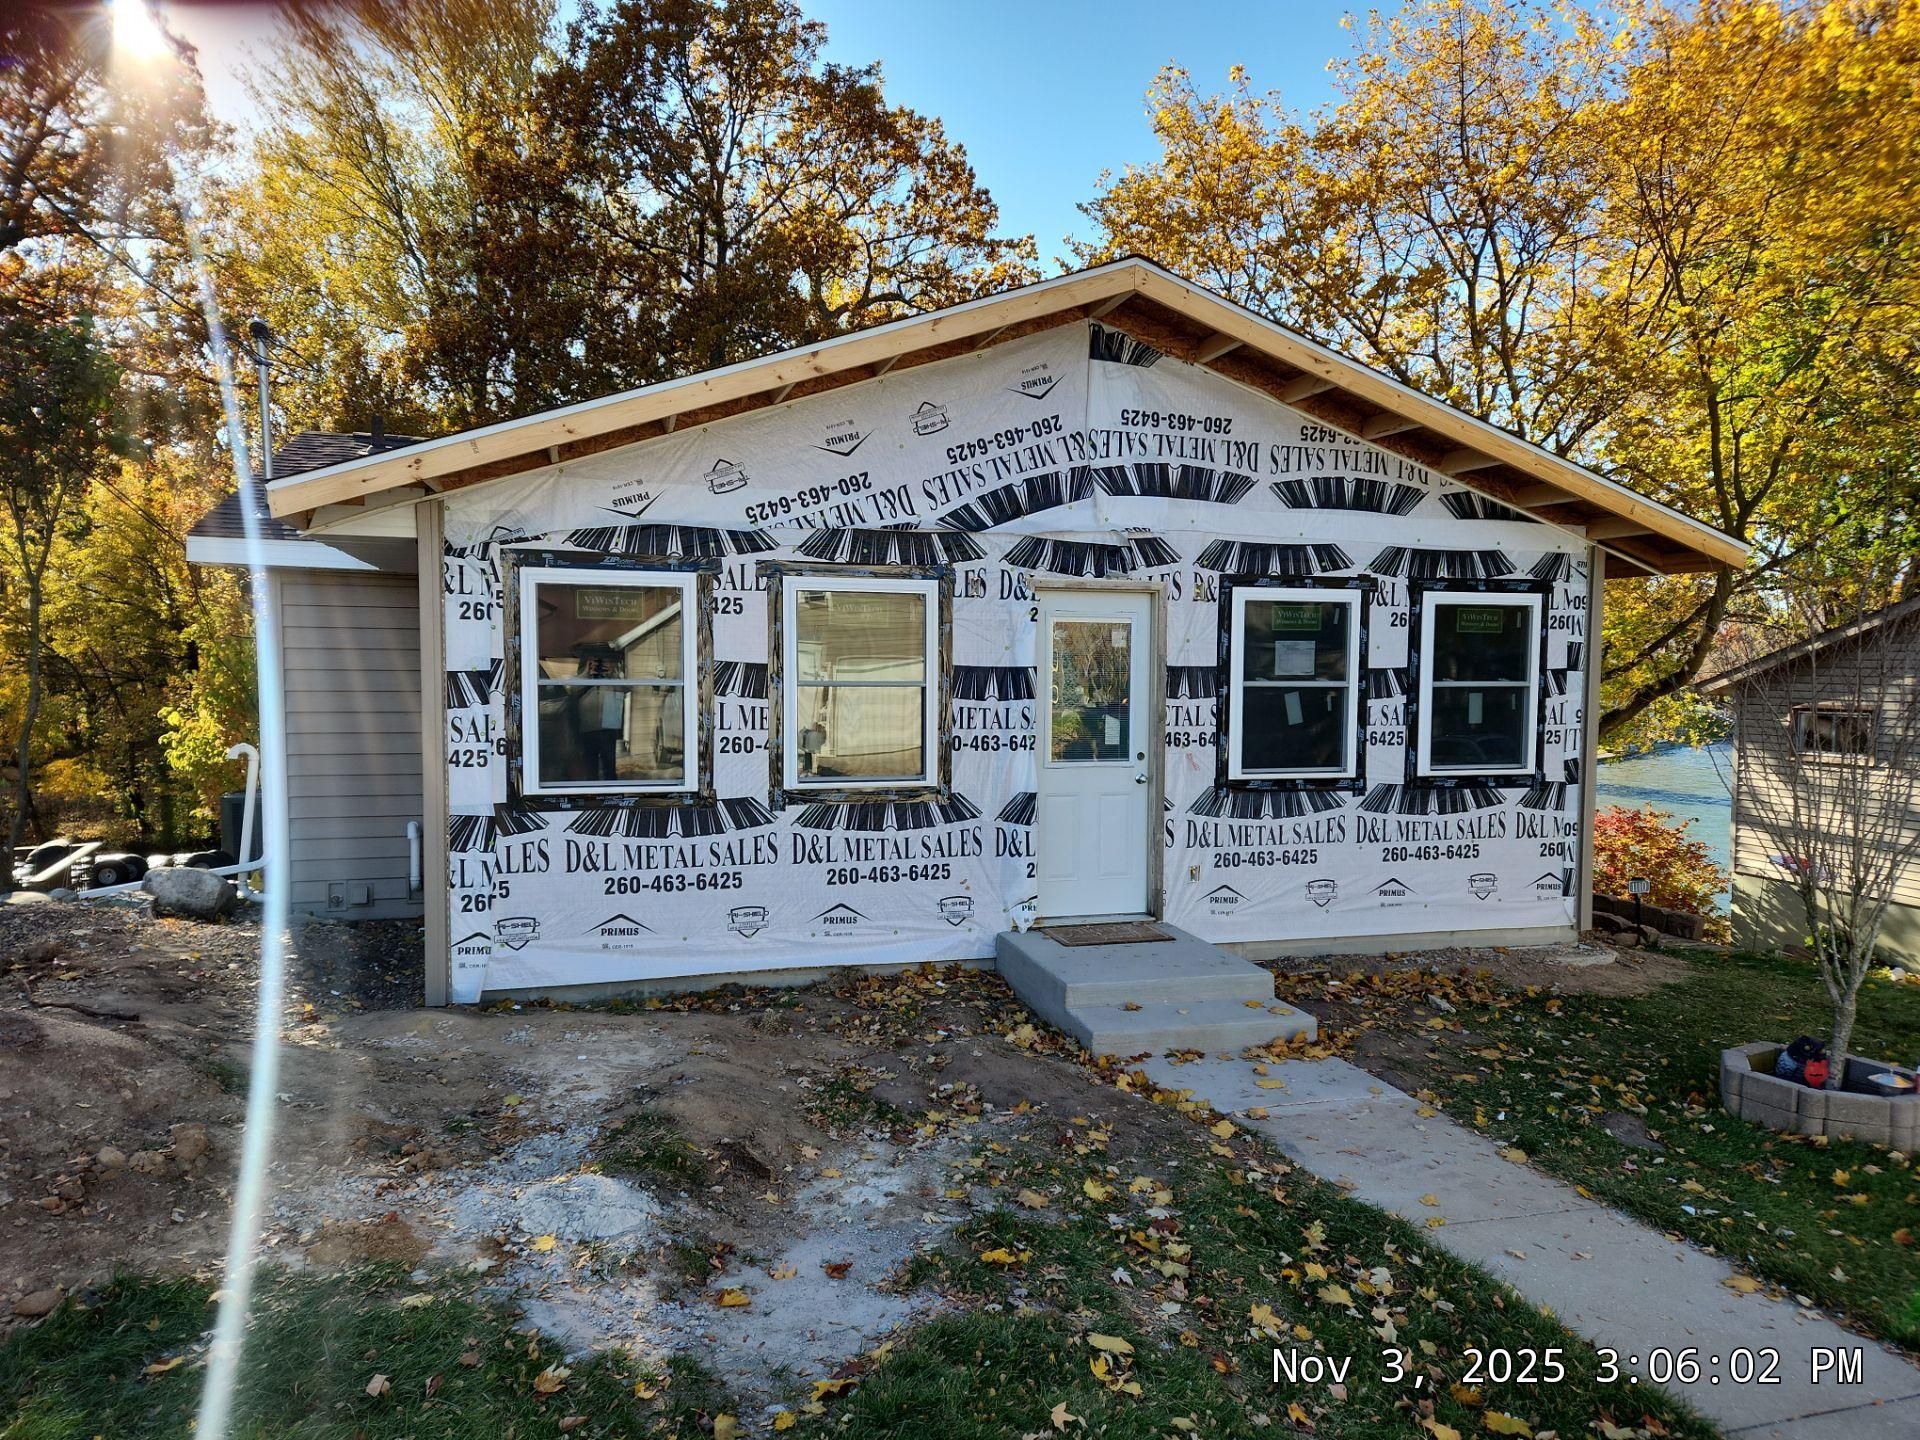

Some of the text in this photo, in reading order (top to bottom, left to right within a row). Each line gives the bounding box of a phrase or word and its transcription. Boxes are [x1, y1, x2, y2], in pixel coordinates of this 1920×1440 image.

[1020, 376, 1053, 391] PRIMUS
[1121, 408, 1232, 435] 260-463-6425
[825, 431, 860, 447] PRIMUS
[946, 414, 1063, 465] 260-463-6425
[1088, 428, 1260, 473] D&L METAL SALES
[985, 442, 1058, 481] METAL
[1270, 443, 1325, 475] SALES
[1327, 447, 1389, 476] METAL
[611, 491, 651, 508] PRIMUS
[745, 471, 873, 524] 260-463-6425
[866, 483, 917, 521] D&L
[922, 463, 987, 512] SALES
[1186, 814, 1346, 849] D&L METAL SALES
[1356, 811, 1507, 844] D&L METAL SALES
[1515, 811, 1549, 840] D&L
[565, 832, 778, 874] D&L METAL SALES
[792, 825, 983, 865] D&L METAL SALES
[995, 826, 1036, 858] D&L
[1382, 843, 1480, 863] 260-463-6425
[1213, 849, 1318, 869] 260-463-6425
[604, 871, 743, 896] 260-463-6425
[826, 863, 951, 886] 260-463-6425
[1536, 883, 1562, 891] PRIMUS
[1209, 896, 1239, 905] PRIMUS
[1378, 888, 1406, 897] PRIMUS
[600, 927, 639, 937] PRIMUS
[823, 915, 858, 925] PRIMUS
